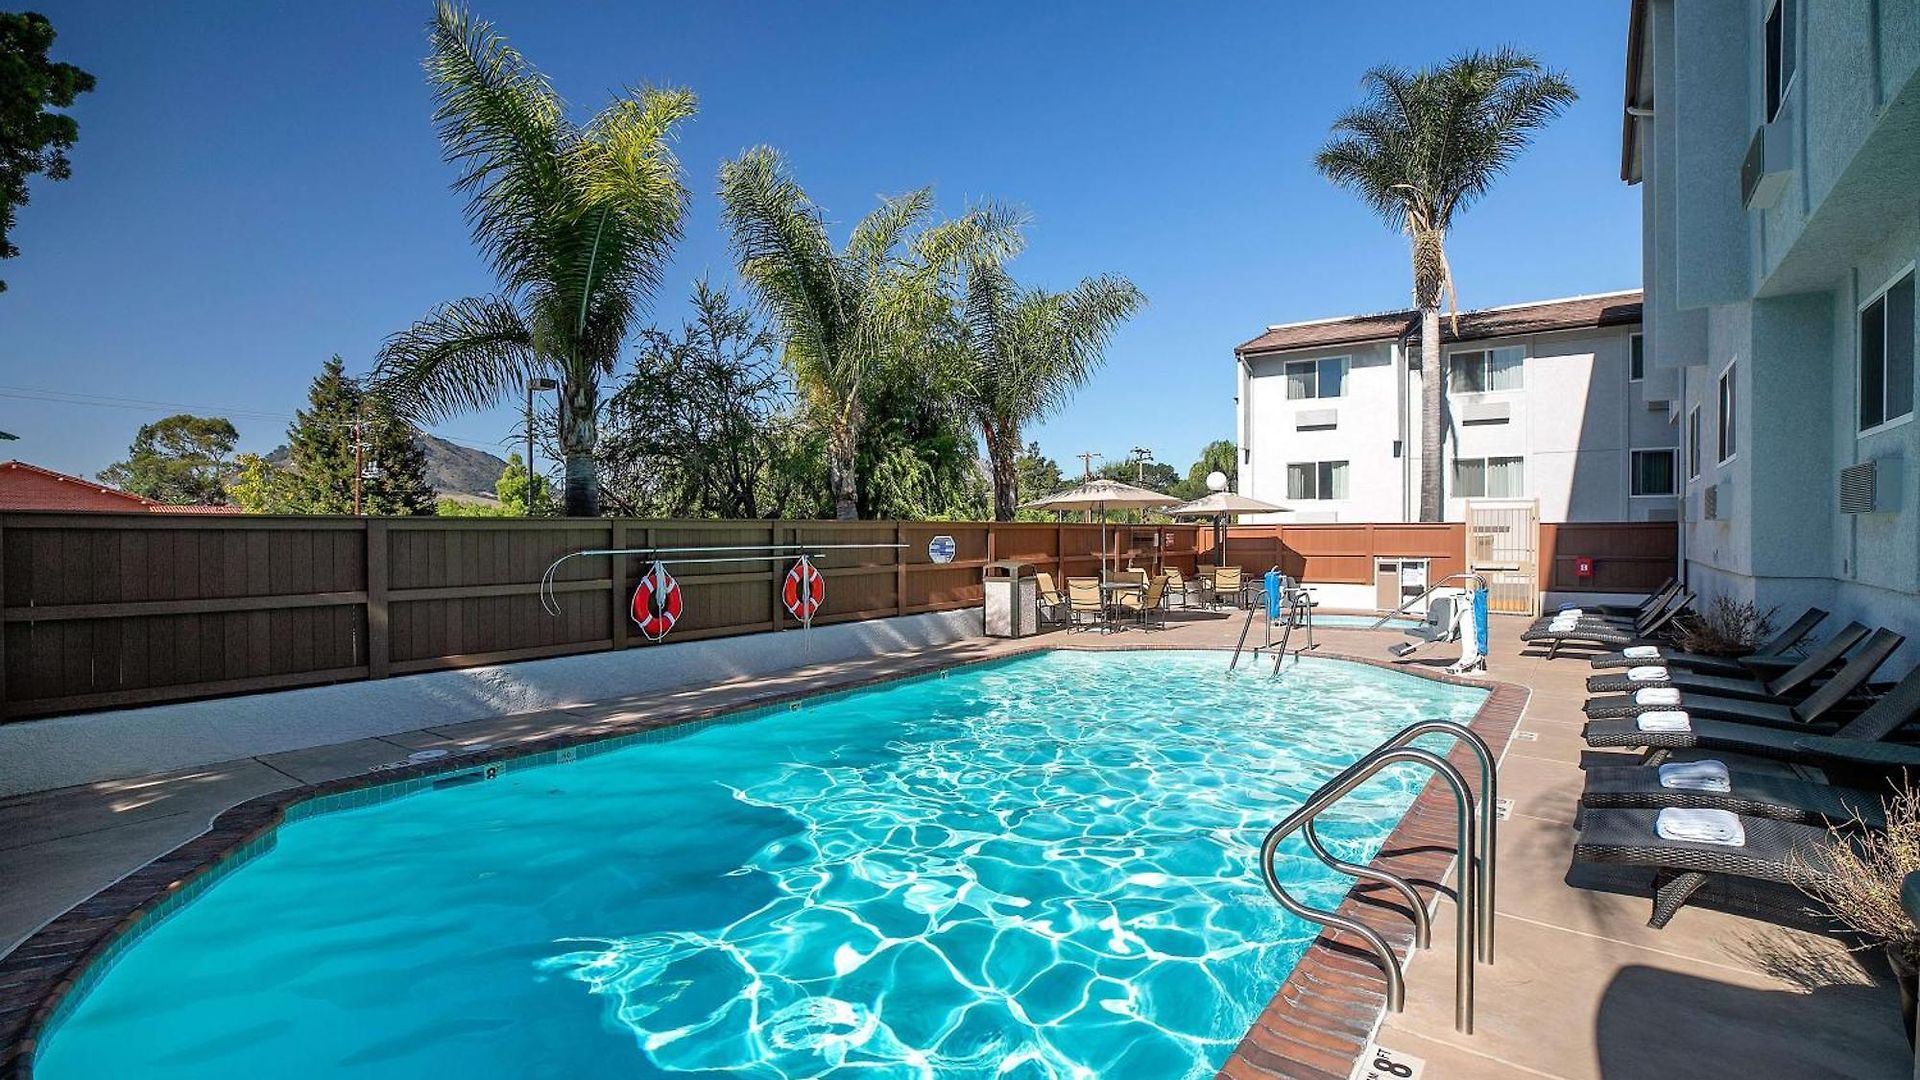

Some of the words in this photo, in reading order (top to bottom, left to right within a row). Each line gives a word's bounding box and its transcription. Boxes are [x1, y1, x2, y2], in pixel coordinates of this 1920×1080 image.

[487, 767, 496, 779] 8
[1376, 1048, 1391, 1060] FT
[1373, 1058, 1412, 1078] 8
